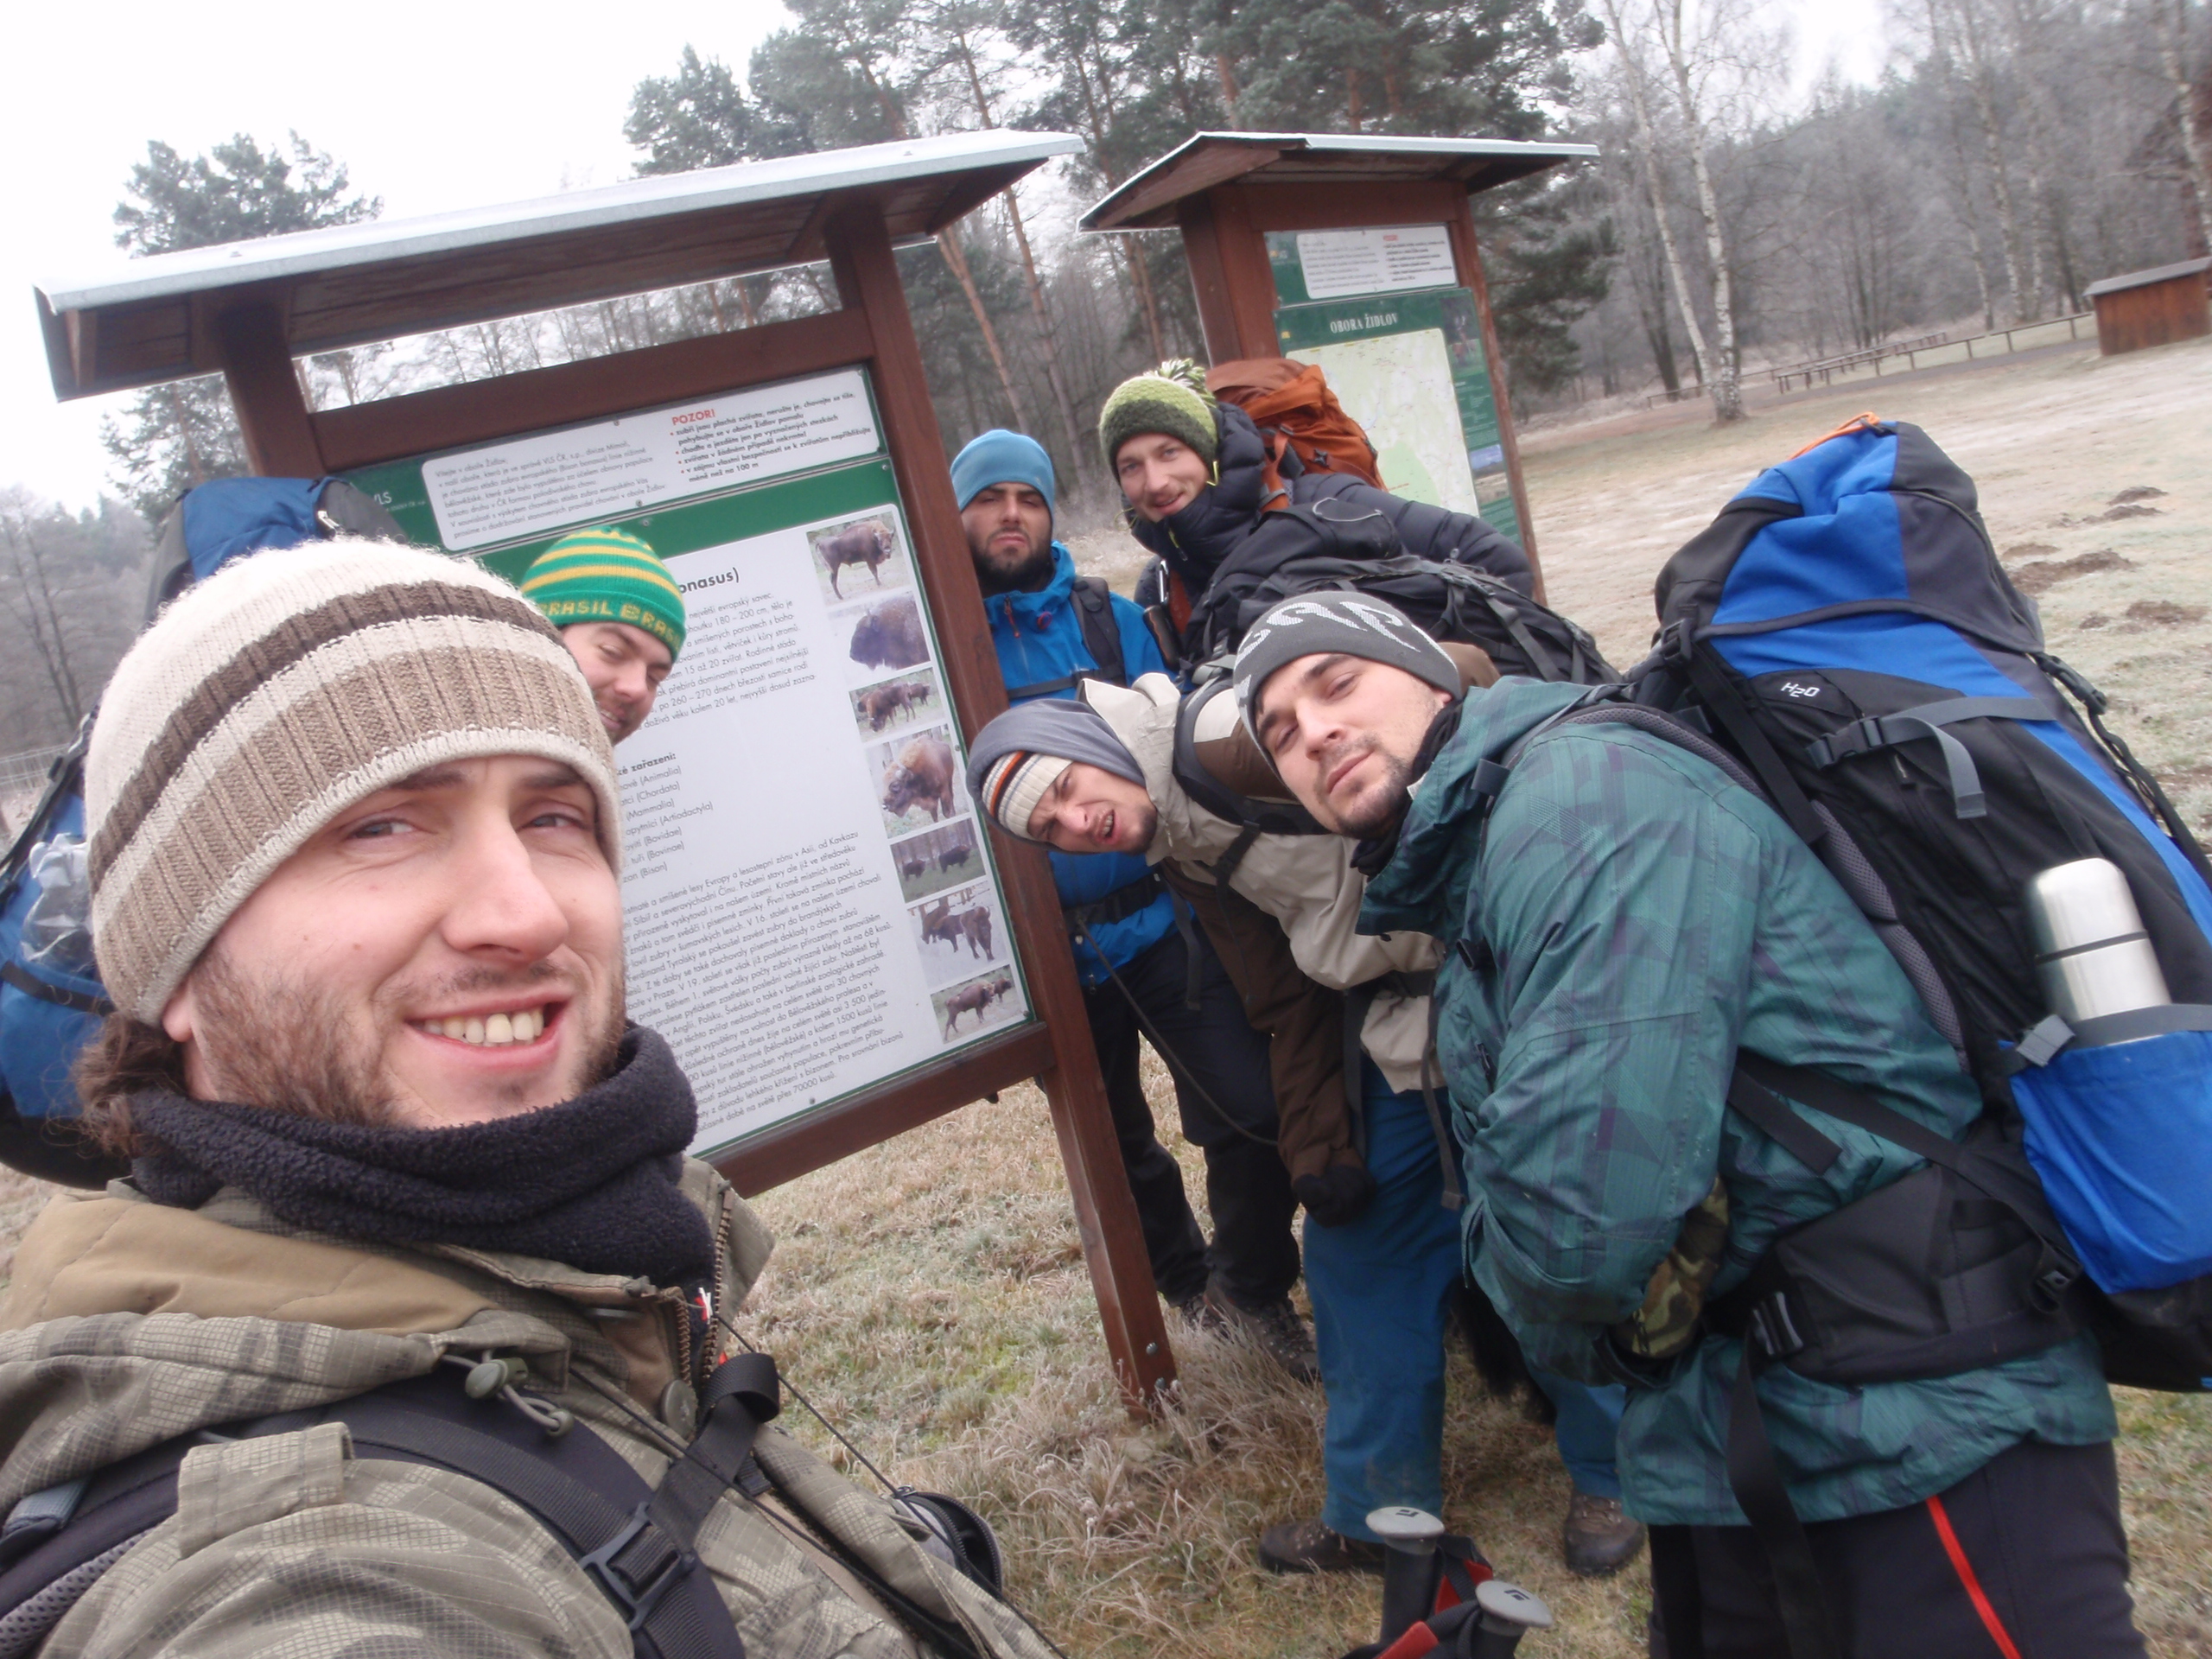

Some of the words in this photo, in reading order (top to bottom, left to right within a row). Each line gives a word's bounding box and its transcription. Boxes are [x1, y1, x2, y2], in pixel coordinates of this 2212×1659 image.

[1330, 318, 1363, 334] OBORA
[1364, 313, 1398, 328] ŽIDLOV
[671, 409, 715, 425] POZOR!
[620, 602, 682, 652] BRASI
[1780, 682, 1821, 698] H2O
